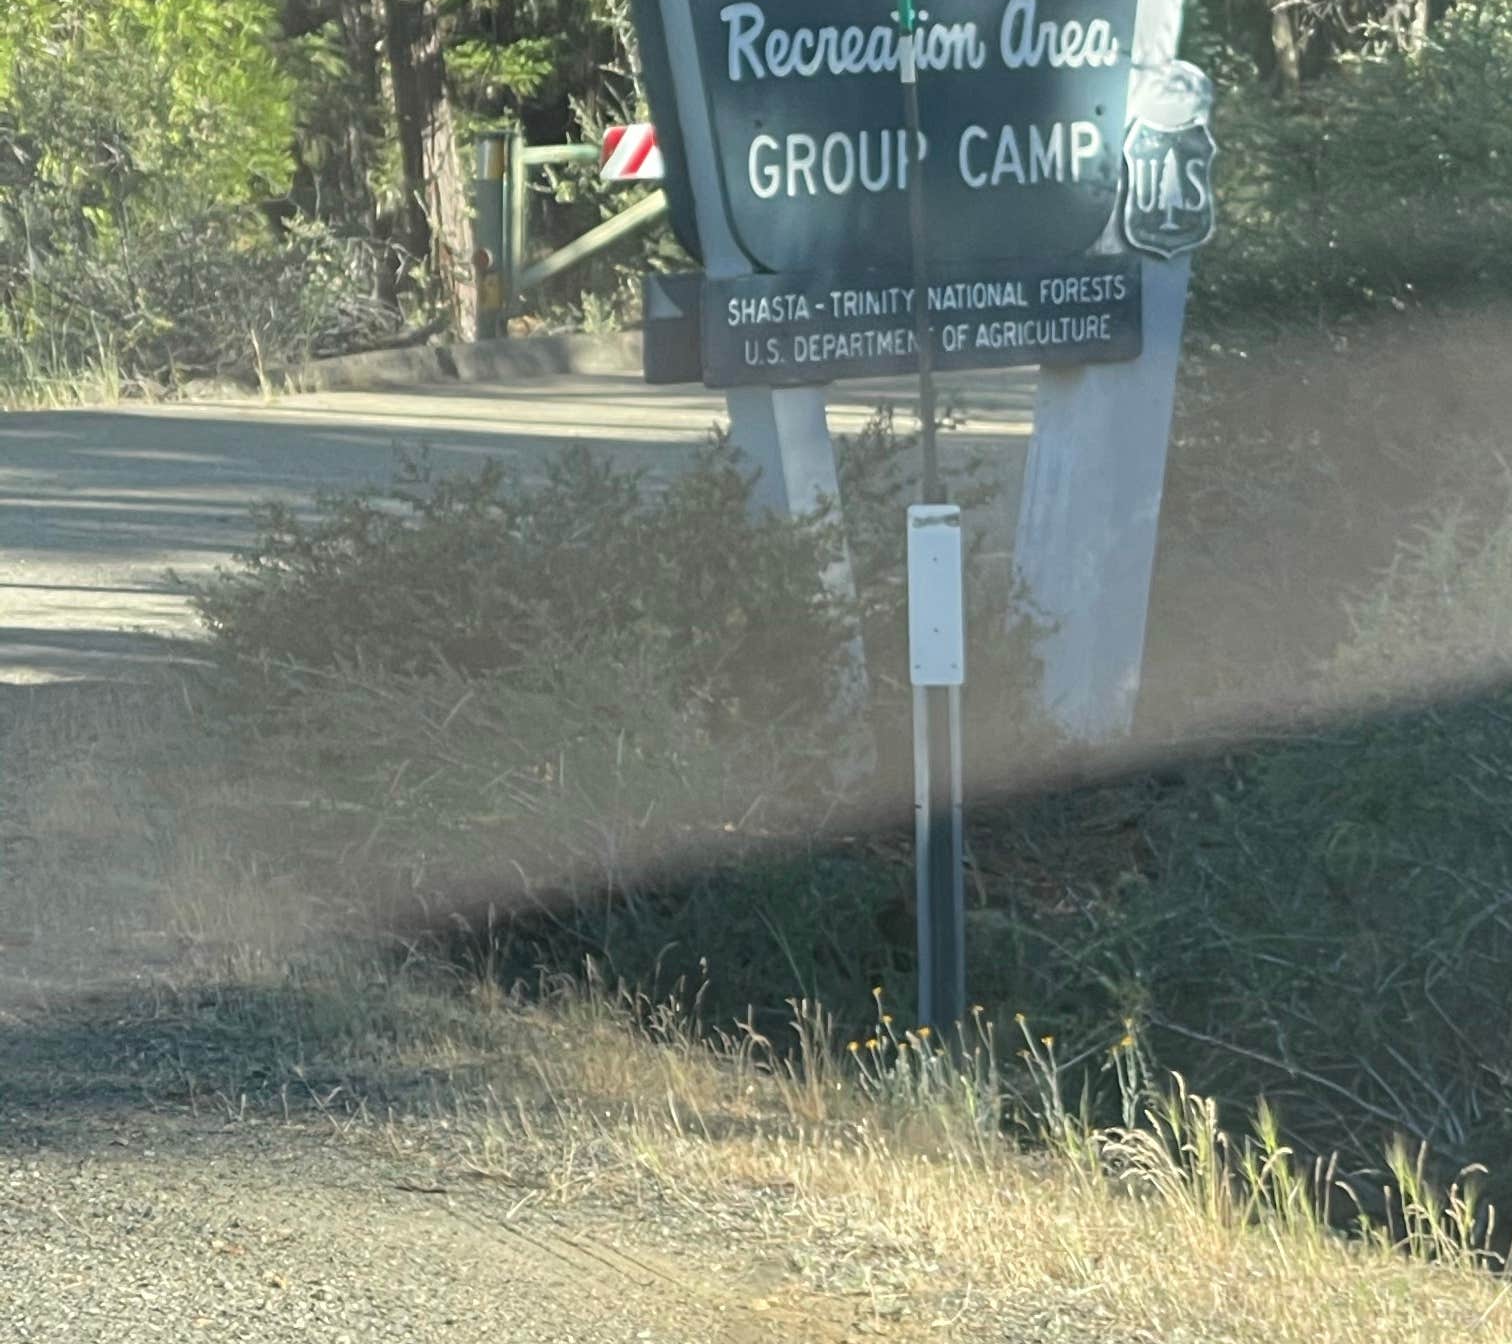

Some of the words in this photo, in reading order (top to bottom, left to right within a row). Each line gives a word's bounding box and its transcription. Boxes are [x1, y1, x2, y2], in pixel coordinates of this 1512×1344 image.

[958, 121, 1102, 189] CAMP
[927, 281, 1029, 311] NATIONAL
[1039, 274, 1127, 305] FORESTS
[794, 327, 934, 362] DEPARTMEN
[942, 323, 970, 353] OF
[975, 314, 1111, 349] AGRICULTURE
